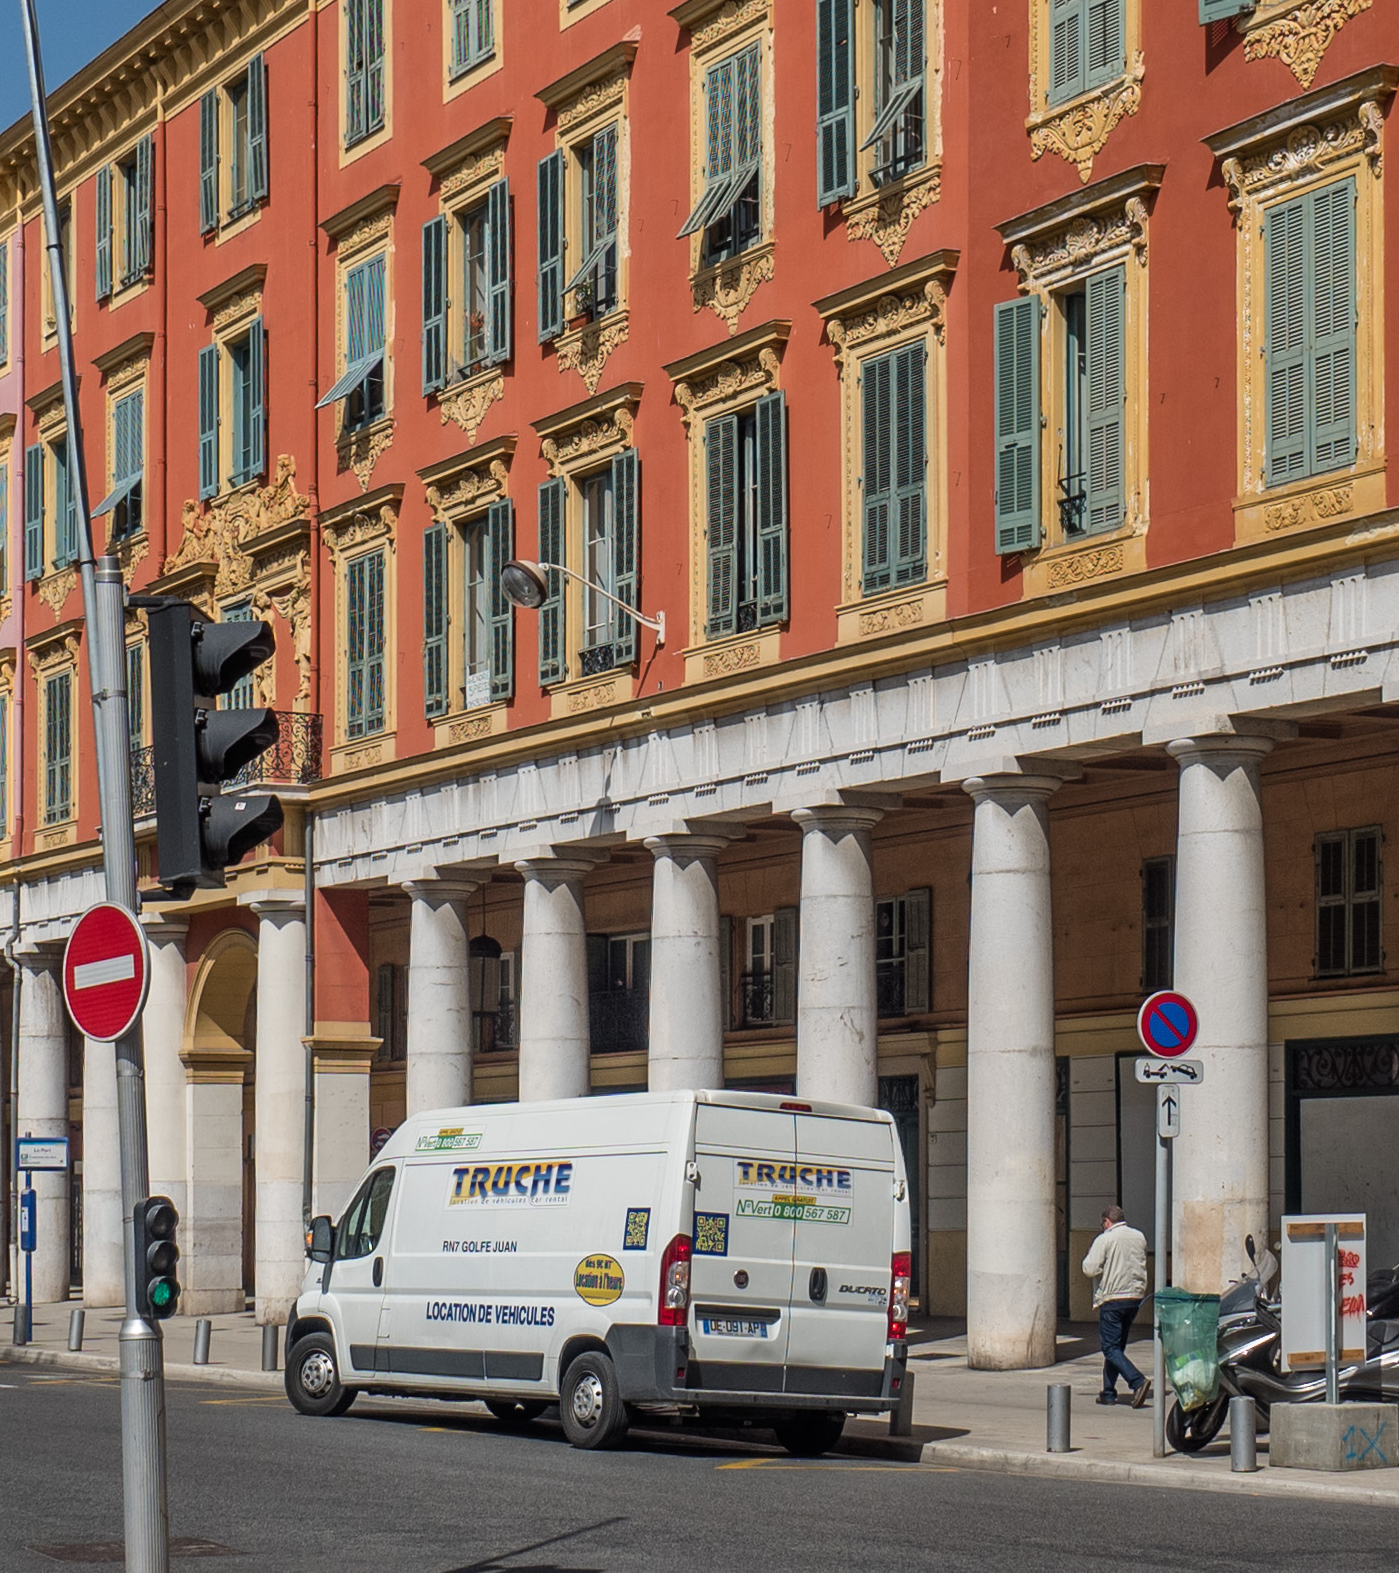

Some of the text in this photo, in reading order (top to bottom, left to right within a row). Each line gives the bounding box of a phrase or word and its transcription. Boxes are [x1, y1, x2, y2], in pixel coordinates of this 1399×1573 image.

[453, 1163, 573, 1198] TRUCHE
[737, 1162, 851, 1189] TRUCHE
[545, 1195, 568, 1203] rental
[774, 1206, 781, 1216] 0
[783, 1206, 802, 1218] 800
[805, 1208, 824, 1218] 567
[826, 1209, 846, 1220] 587
[442, 1241, 517, 1253] RN7 GOLFE JUAN
[839, 1284, 887, 1295] DUCATO
[426, 1302, 555, 1326] LOCATION DE VEHICULES
